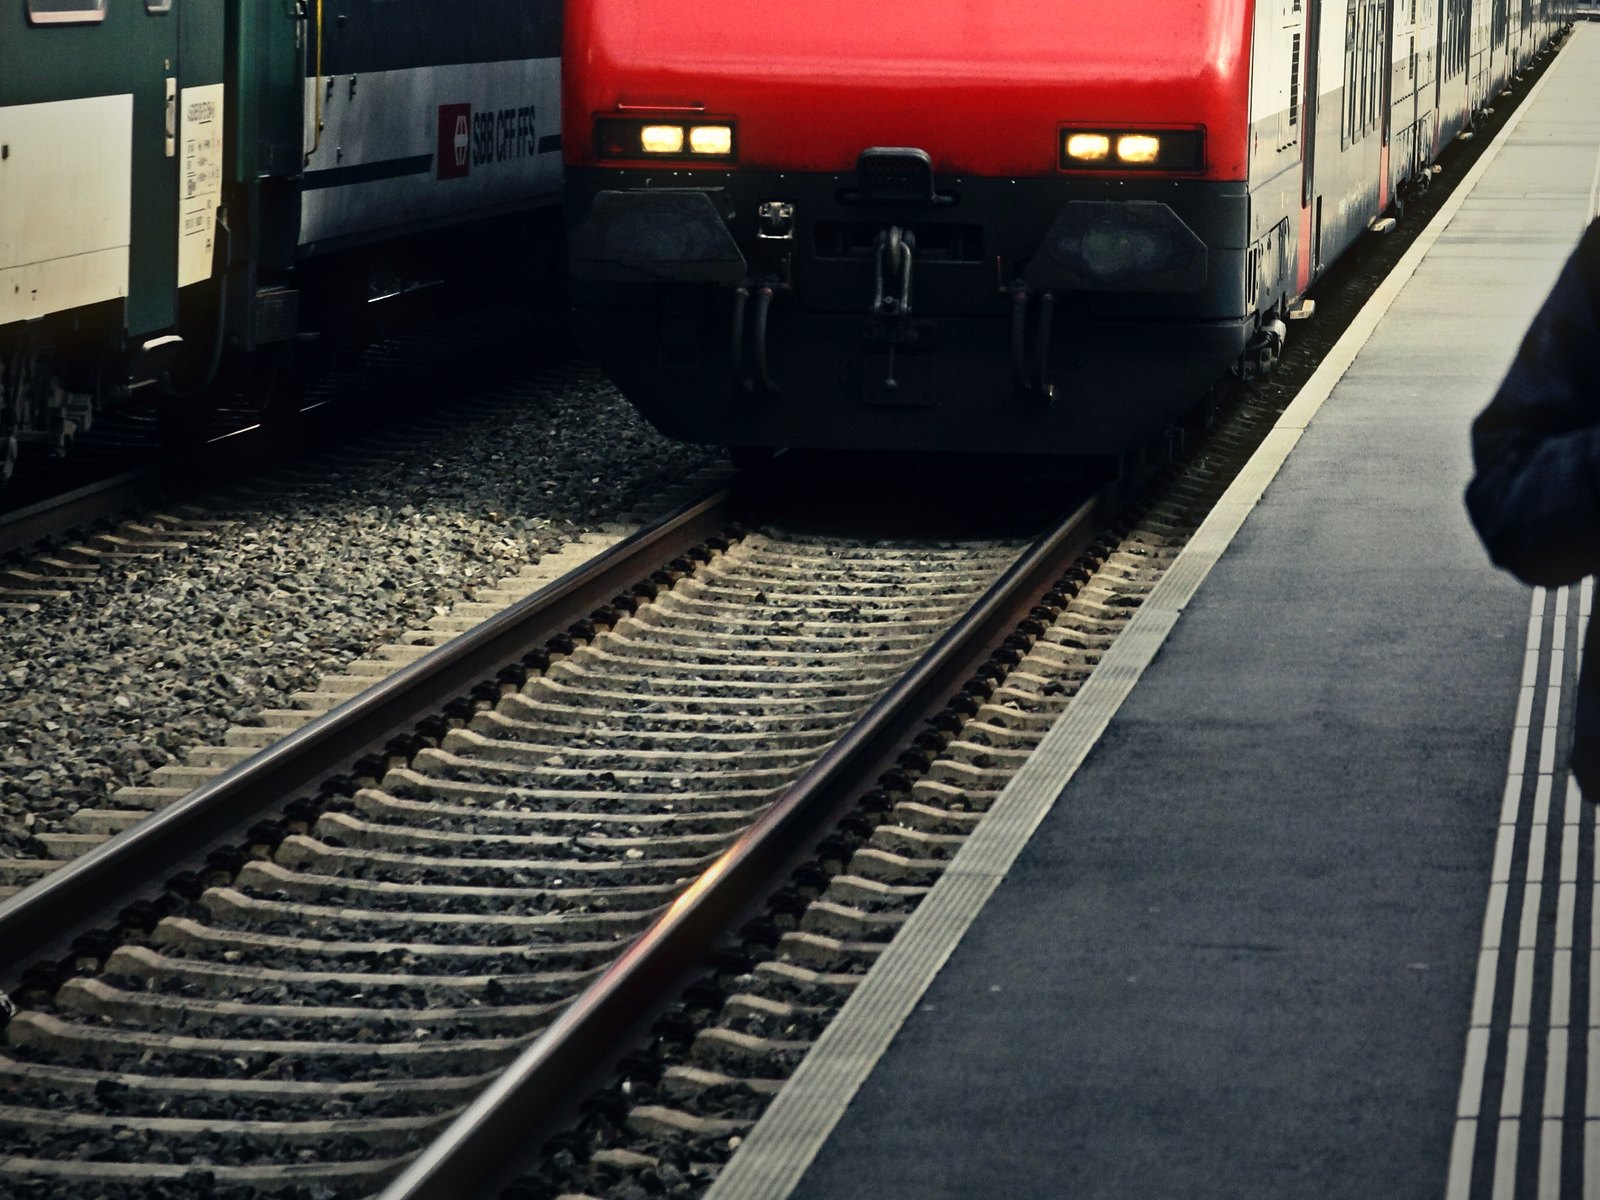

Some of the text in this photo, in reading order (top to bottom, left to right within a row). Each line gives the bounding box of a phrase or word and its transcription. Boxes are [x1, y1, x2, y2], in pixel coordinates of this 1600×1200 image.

[473, 105, 535, 166] SBB CFF FFS
